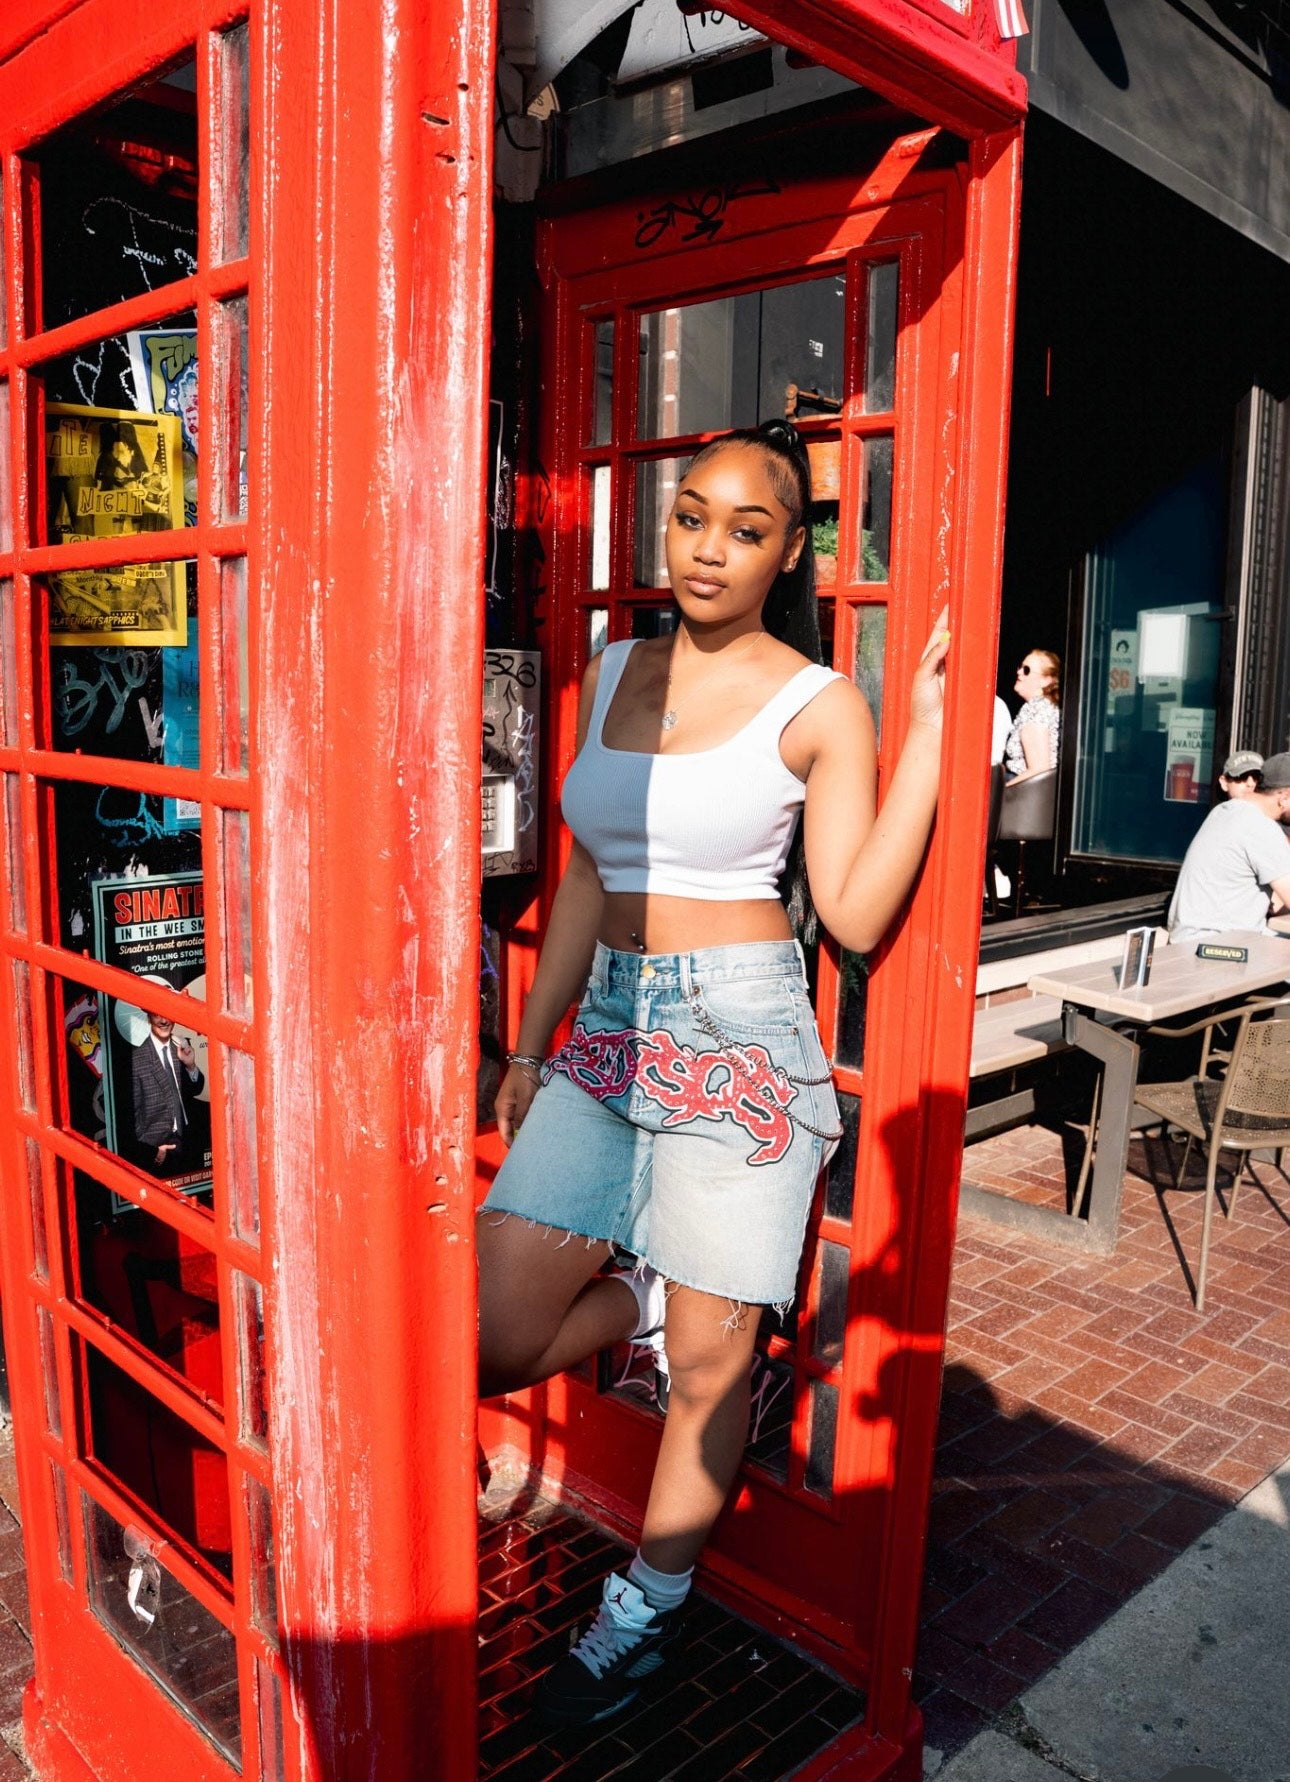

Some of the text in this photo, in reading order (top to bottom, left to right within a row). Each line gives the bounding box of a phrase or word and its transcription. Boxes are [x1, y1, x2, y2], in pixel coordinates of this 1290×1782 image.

[80, 488, 145, 515] NIGHT
[1187, 731, 1207, 739] NOW
[121, 928, 132, 941] IN
[139, 925, 158, 938] THE
[164, 921, 185, 935] WEE
[119, 942, 154, 955] Sinatra's
[155, 940, 175, 950] most
[1205, 948, 1242, 958] RESERVED
[146, 952, 179, 962] ROLLING
[149, 962, 158, 971] of
[157, 961, 169, 970] the
[169, 957, 197, 971] greatest
